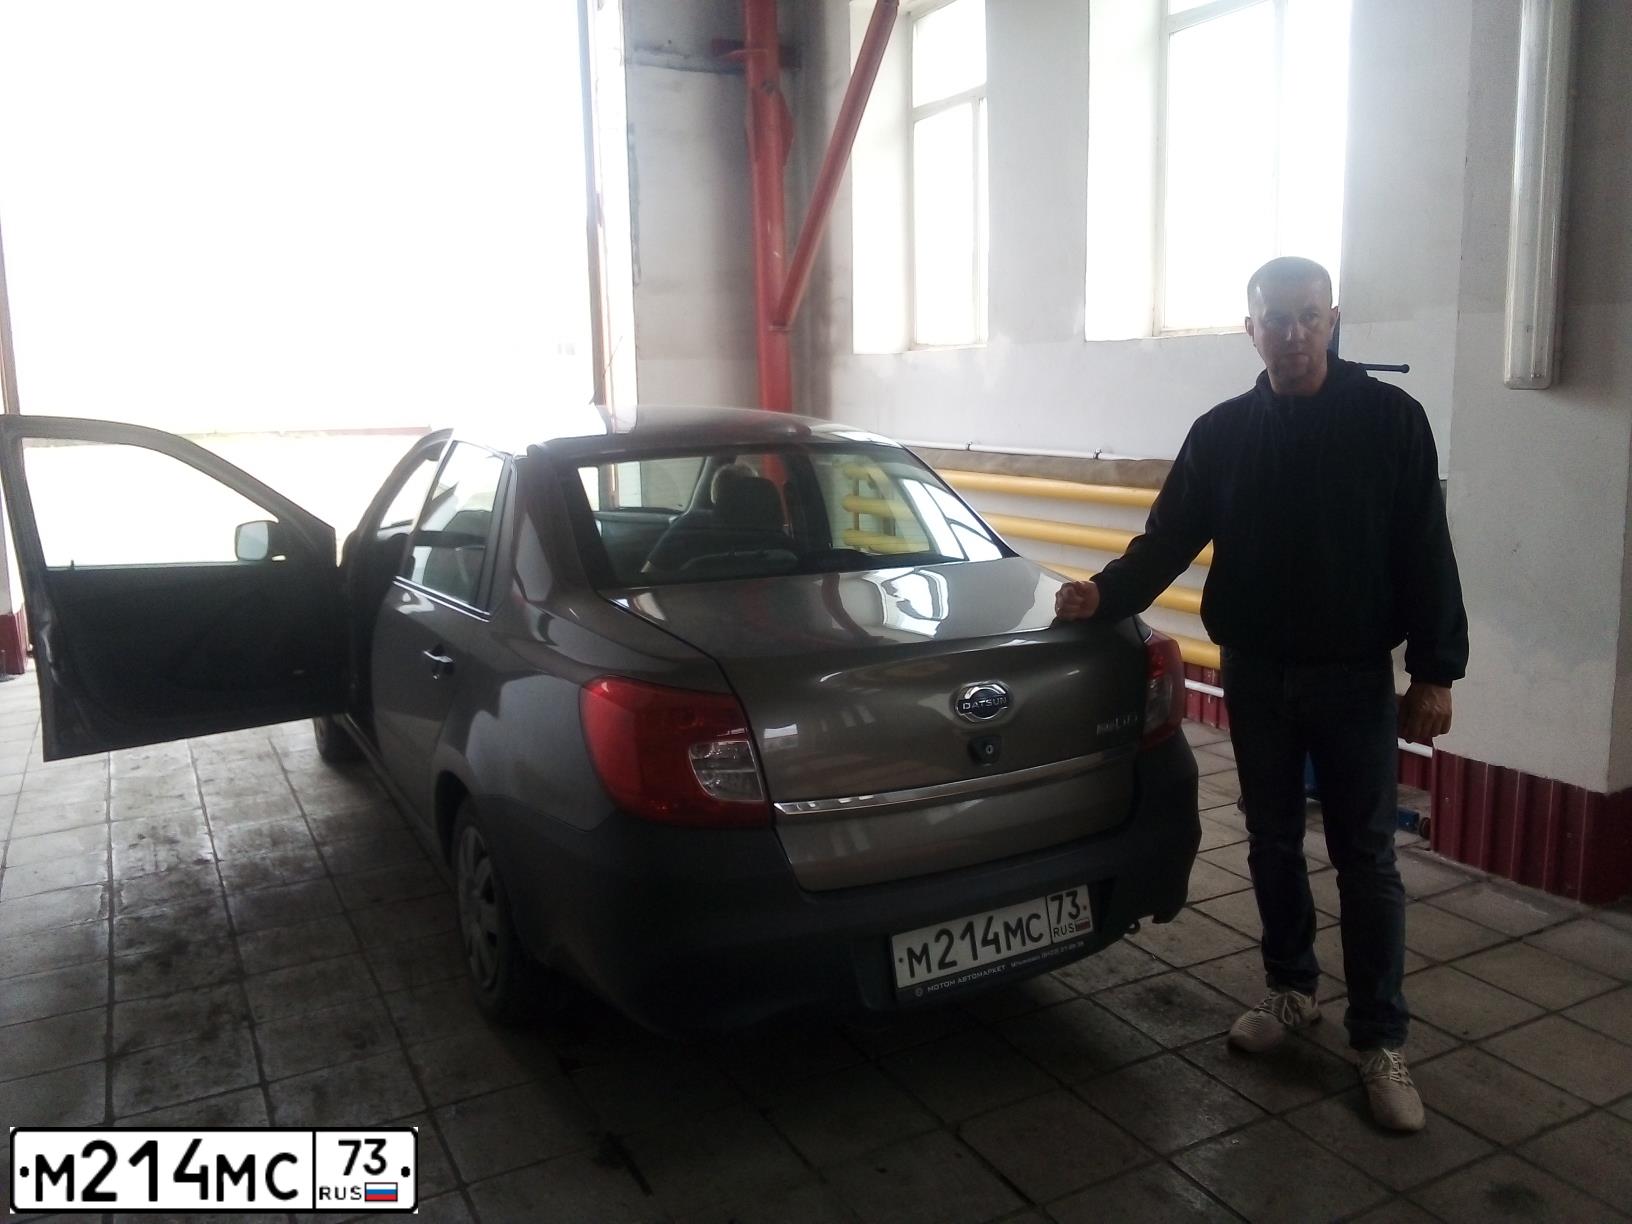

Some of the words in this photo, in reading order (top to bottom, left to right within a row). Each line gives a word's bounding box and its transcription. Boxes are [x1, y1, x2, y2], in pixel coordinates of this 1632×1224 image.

[962, 696, 1008, 711] DATSUN
[1050, 890, 1081, 924] 73
[1053, 921, 1075, 938] RUS
